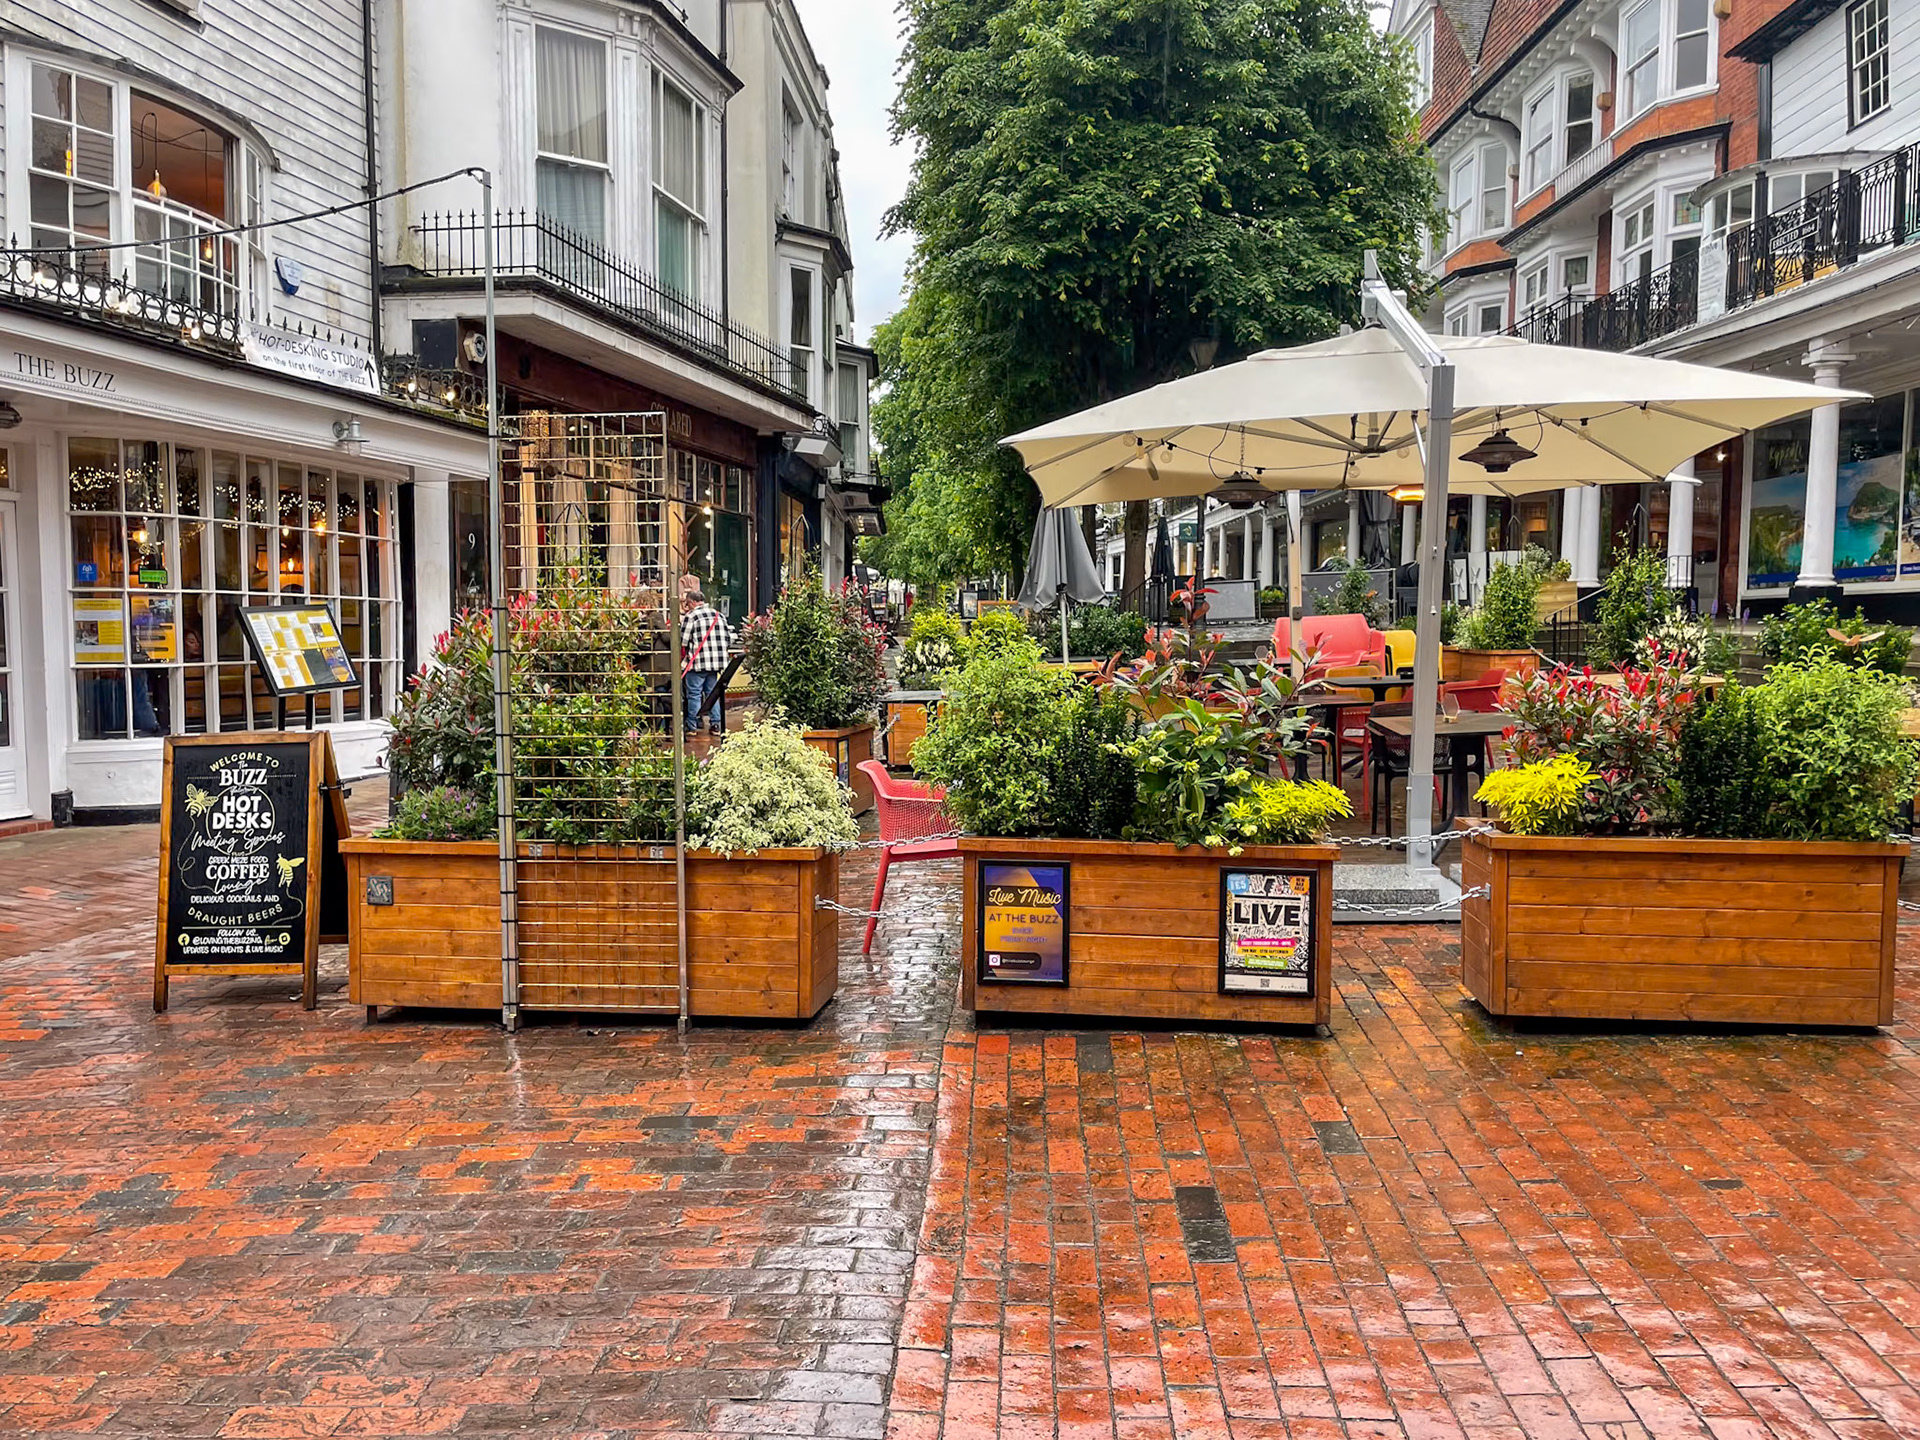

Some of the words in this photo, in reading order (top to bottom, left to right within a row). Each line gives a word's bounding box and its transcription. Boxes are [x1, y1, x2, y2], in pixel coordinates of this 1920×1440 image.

[1772, 230, 1799, 249] ERECTED
[258, 332, 328, 361] HOT-DESKING
[331, 351, 365, 370] STUDIO
[13, 352, 56, 380] THE
[64, 363, 116, 392] BUZZ
[262, 354, 273, 362] on
[274, 356, 286, 367] the
[288, 359, 307, 371] first
[308, 362, 325, 375] floor
[327, 369, 336, 377] of
[337, 370, 349, 382] THE
[350, 374, 367, 386] BUZZ
[468, 532, 476, 550] 9
[209, 752, 263, 772] WELCOME
[265, 755, 279, 768] TO
[219, 768, 268, 786] BUZZ
[222, 795, 262, 813] HOT
[212, 812, 272, 830] DESKS
[191, 831, 239, 853] Meeting
[243, 828, 286, 854] Spaces
[208, 856, 230, 865] GREEK
[230, 856, 249, 864] MEZE
[250, 856, 269, 864] FOOD
[205, 863, 270, 880] COFFEE
[214, 878, 268, 895] Lounge
[190, 895, 225, 904] DELICIOUS
[226, 894, 262, 903] COCKTAILS
[263, 894, 280, 903] AND
[988, 887, 1015, 906] Live
[1017, 887, 1062, 907] Music
[187, 906, 243, 926] DRAUGHT
[247, 903, 283, 923] BEERS
[988, 913, 1002, 922] AT
[1005, 914, 1027, 923] THE
[1029, 914, 1059, 924] BUZZ
[1234, 902, 1301, 926] LIVE
[217, 928, 245, 937] FOLLOW
[183, 945, 209, 955] UPDATES
[210, 945, 220, 953] ON
[220, 945, 244, 954] EVENTS
[245, 945, 251, 953] &
[264, 945, 284, 953] MUSIC
